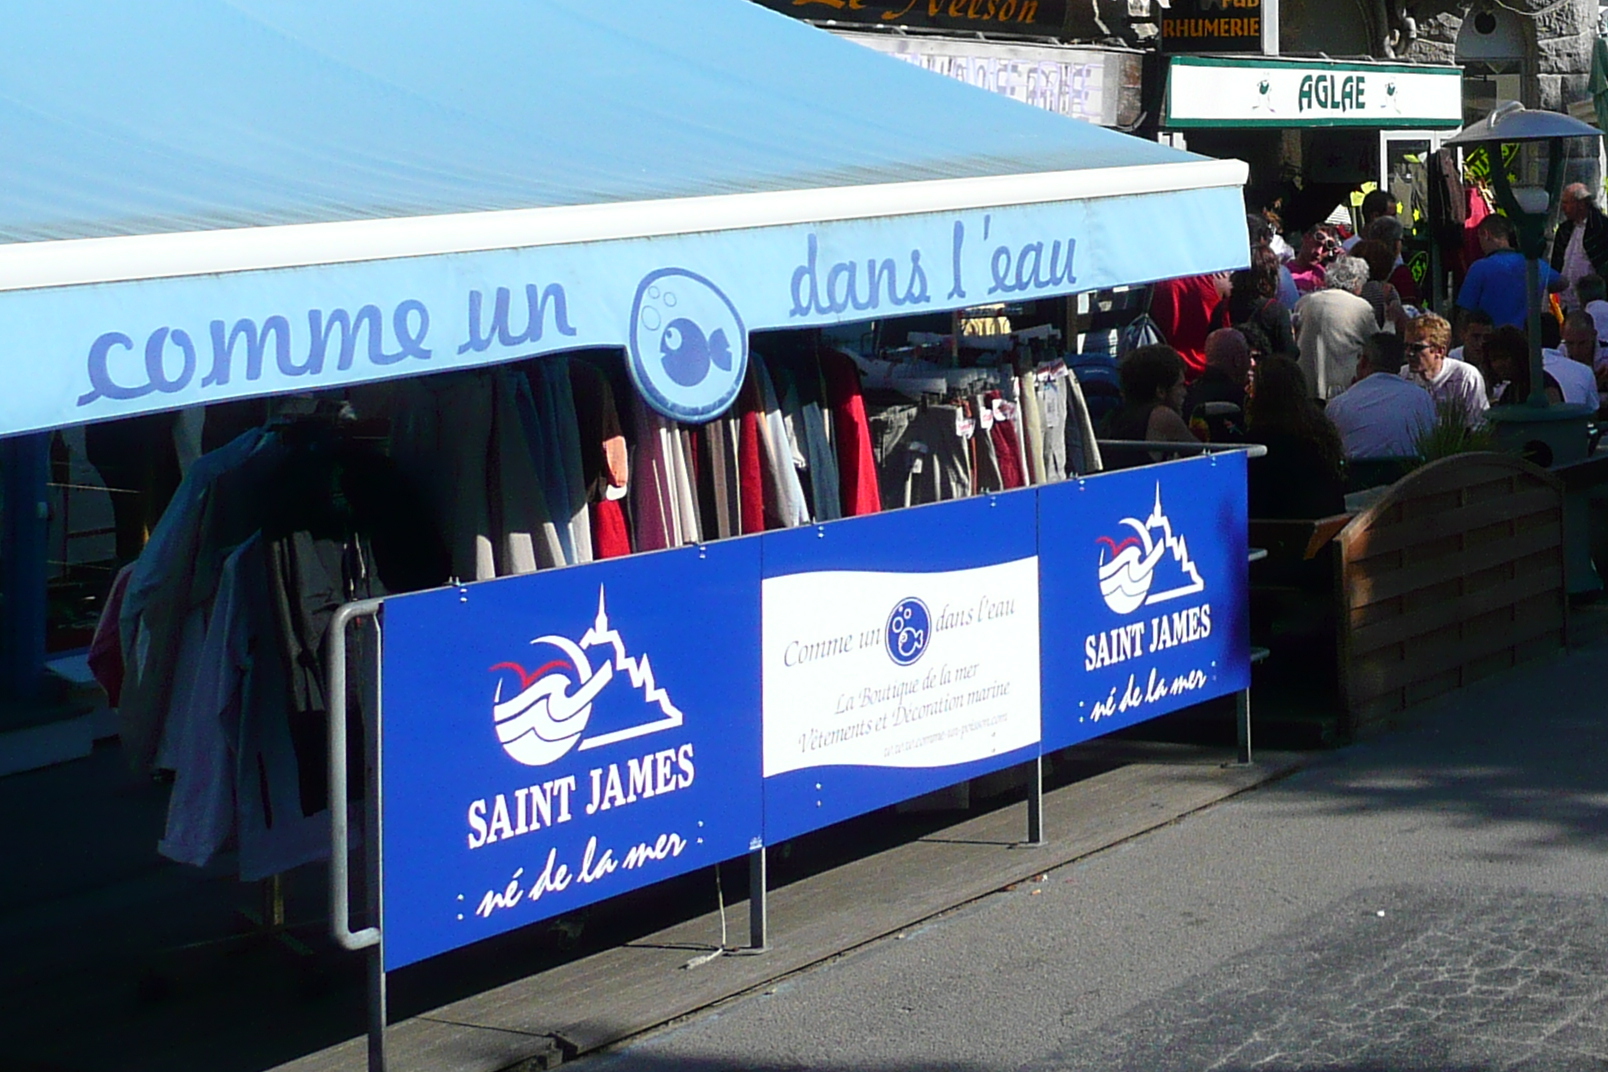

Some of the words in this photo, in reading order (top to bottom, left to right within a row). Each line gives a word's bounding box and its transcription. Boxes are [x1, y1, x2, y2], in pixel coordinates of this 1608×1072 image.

[1163, 17, 1260, 38] RHUMERIE
[1298, 74, 1365, 113] AGLAE
[77, 298, 432, 407] comme
[457, 283, 577, 355] un
[789, 232, 931, 318] dans
[947, 214, 1077, 300] l'eau
[784, 632, 853, 667] Comme
[858, 627, 881, 649] un
[936, 603, 974, 633] dans
[977, 595, 1017, 623] l'eau
[1084, 621, 1145, 671] SAINT
[1149, 603, 1211, 653] JAMES
[834, 693, 854, 716] La
[858, 677, 919, 711] Boutique
[922, 666, 936, 690] de
[939, 663, 951, 687] la
[955, 662, 980, 680] mer
[875, 712, 888, 733] et
[967, 680, 1011, 705] marine
[1090, 686, 1116, 722] né
[1118, 673, 1142, 713] de
[1144, 667, 1168, 703] la
[1170, 669, 1207, 695] mer
[468, 775, 576, 850] SAINT
[585, 743, 695, 815] JAMES
[475, 867, 524, 918] né
[528, 847, 573, 901] de
[577, 836, 619, 883] la
[622, 832, 688, 870] mer
